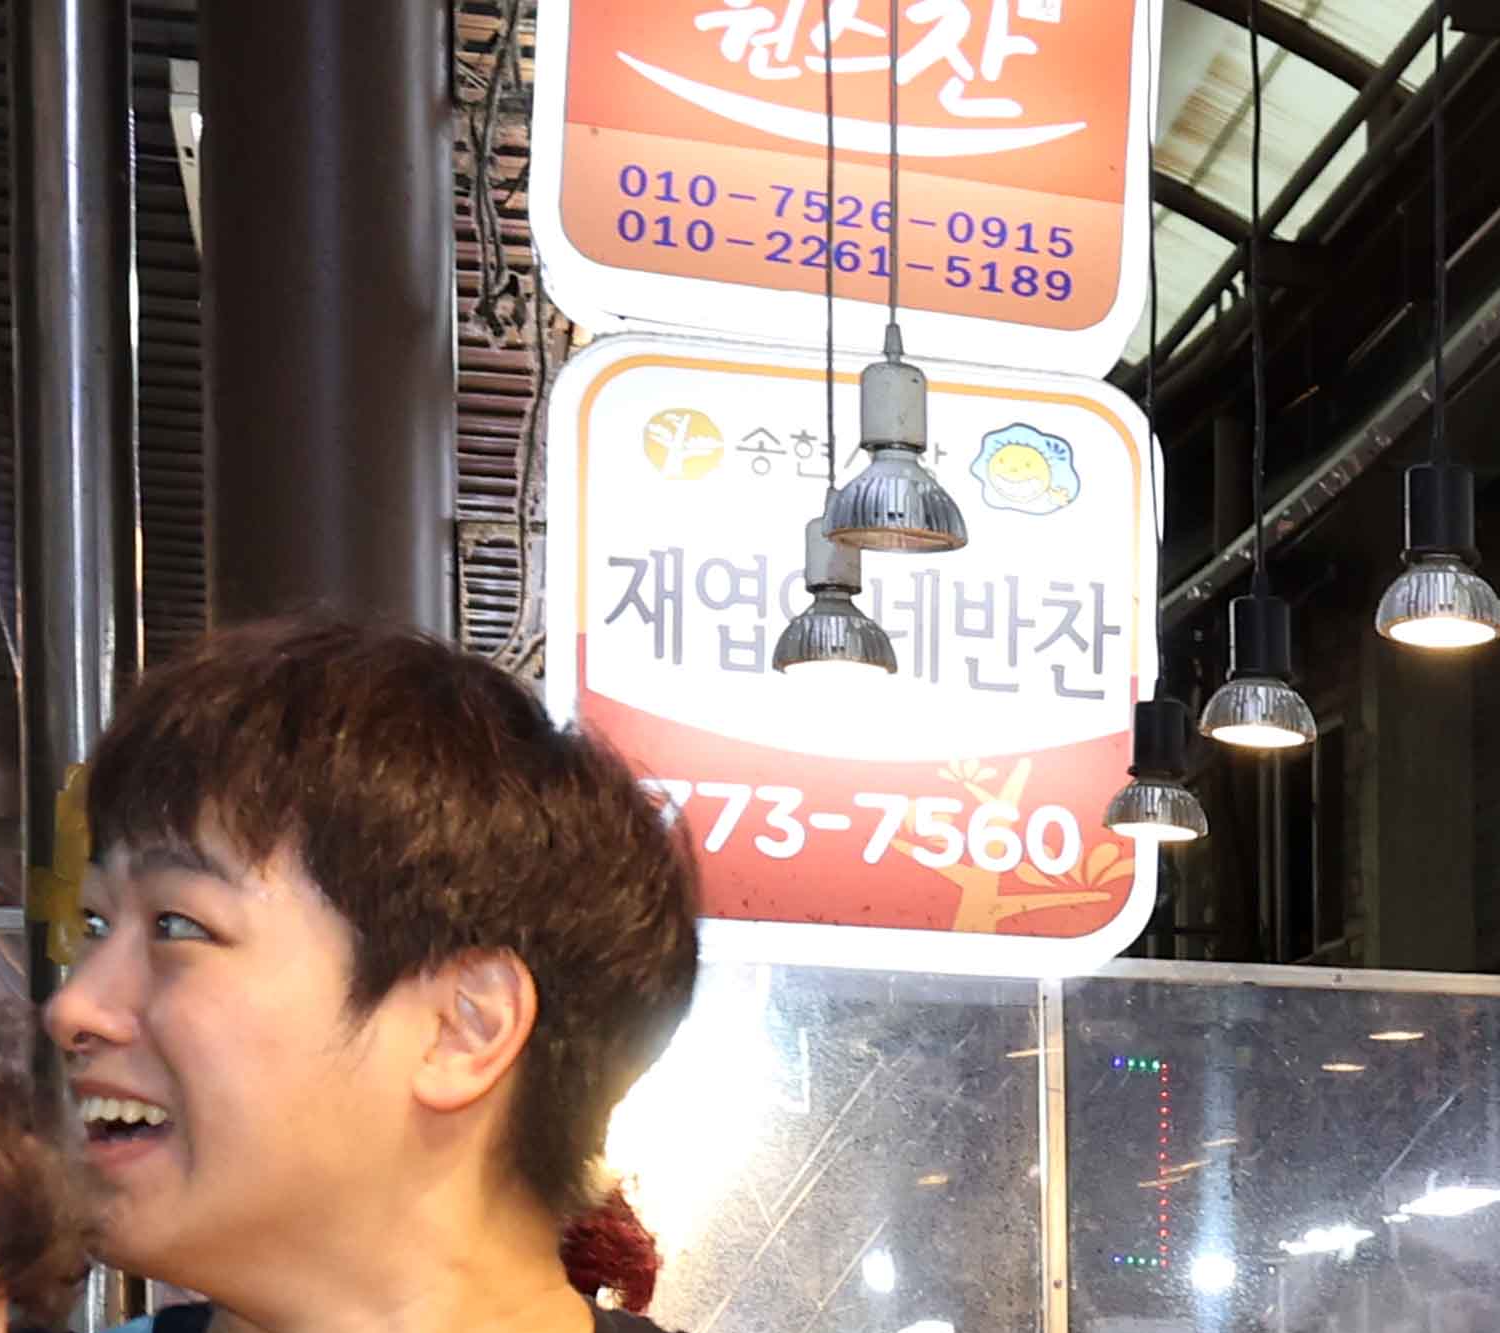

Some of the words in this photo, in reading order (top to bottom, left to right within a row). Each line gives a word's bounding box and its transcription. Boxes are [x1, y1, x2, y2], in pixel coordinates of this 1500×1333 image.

[617, 209, 1073, 301] 010-2261-5189
[619, 164, 1075, 259] 010-7526-0915
[735, 426, 948, 482] 송현
